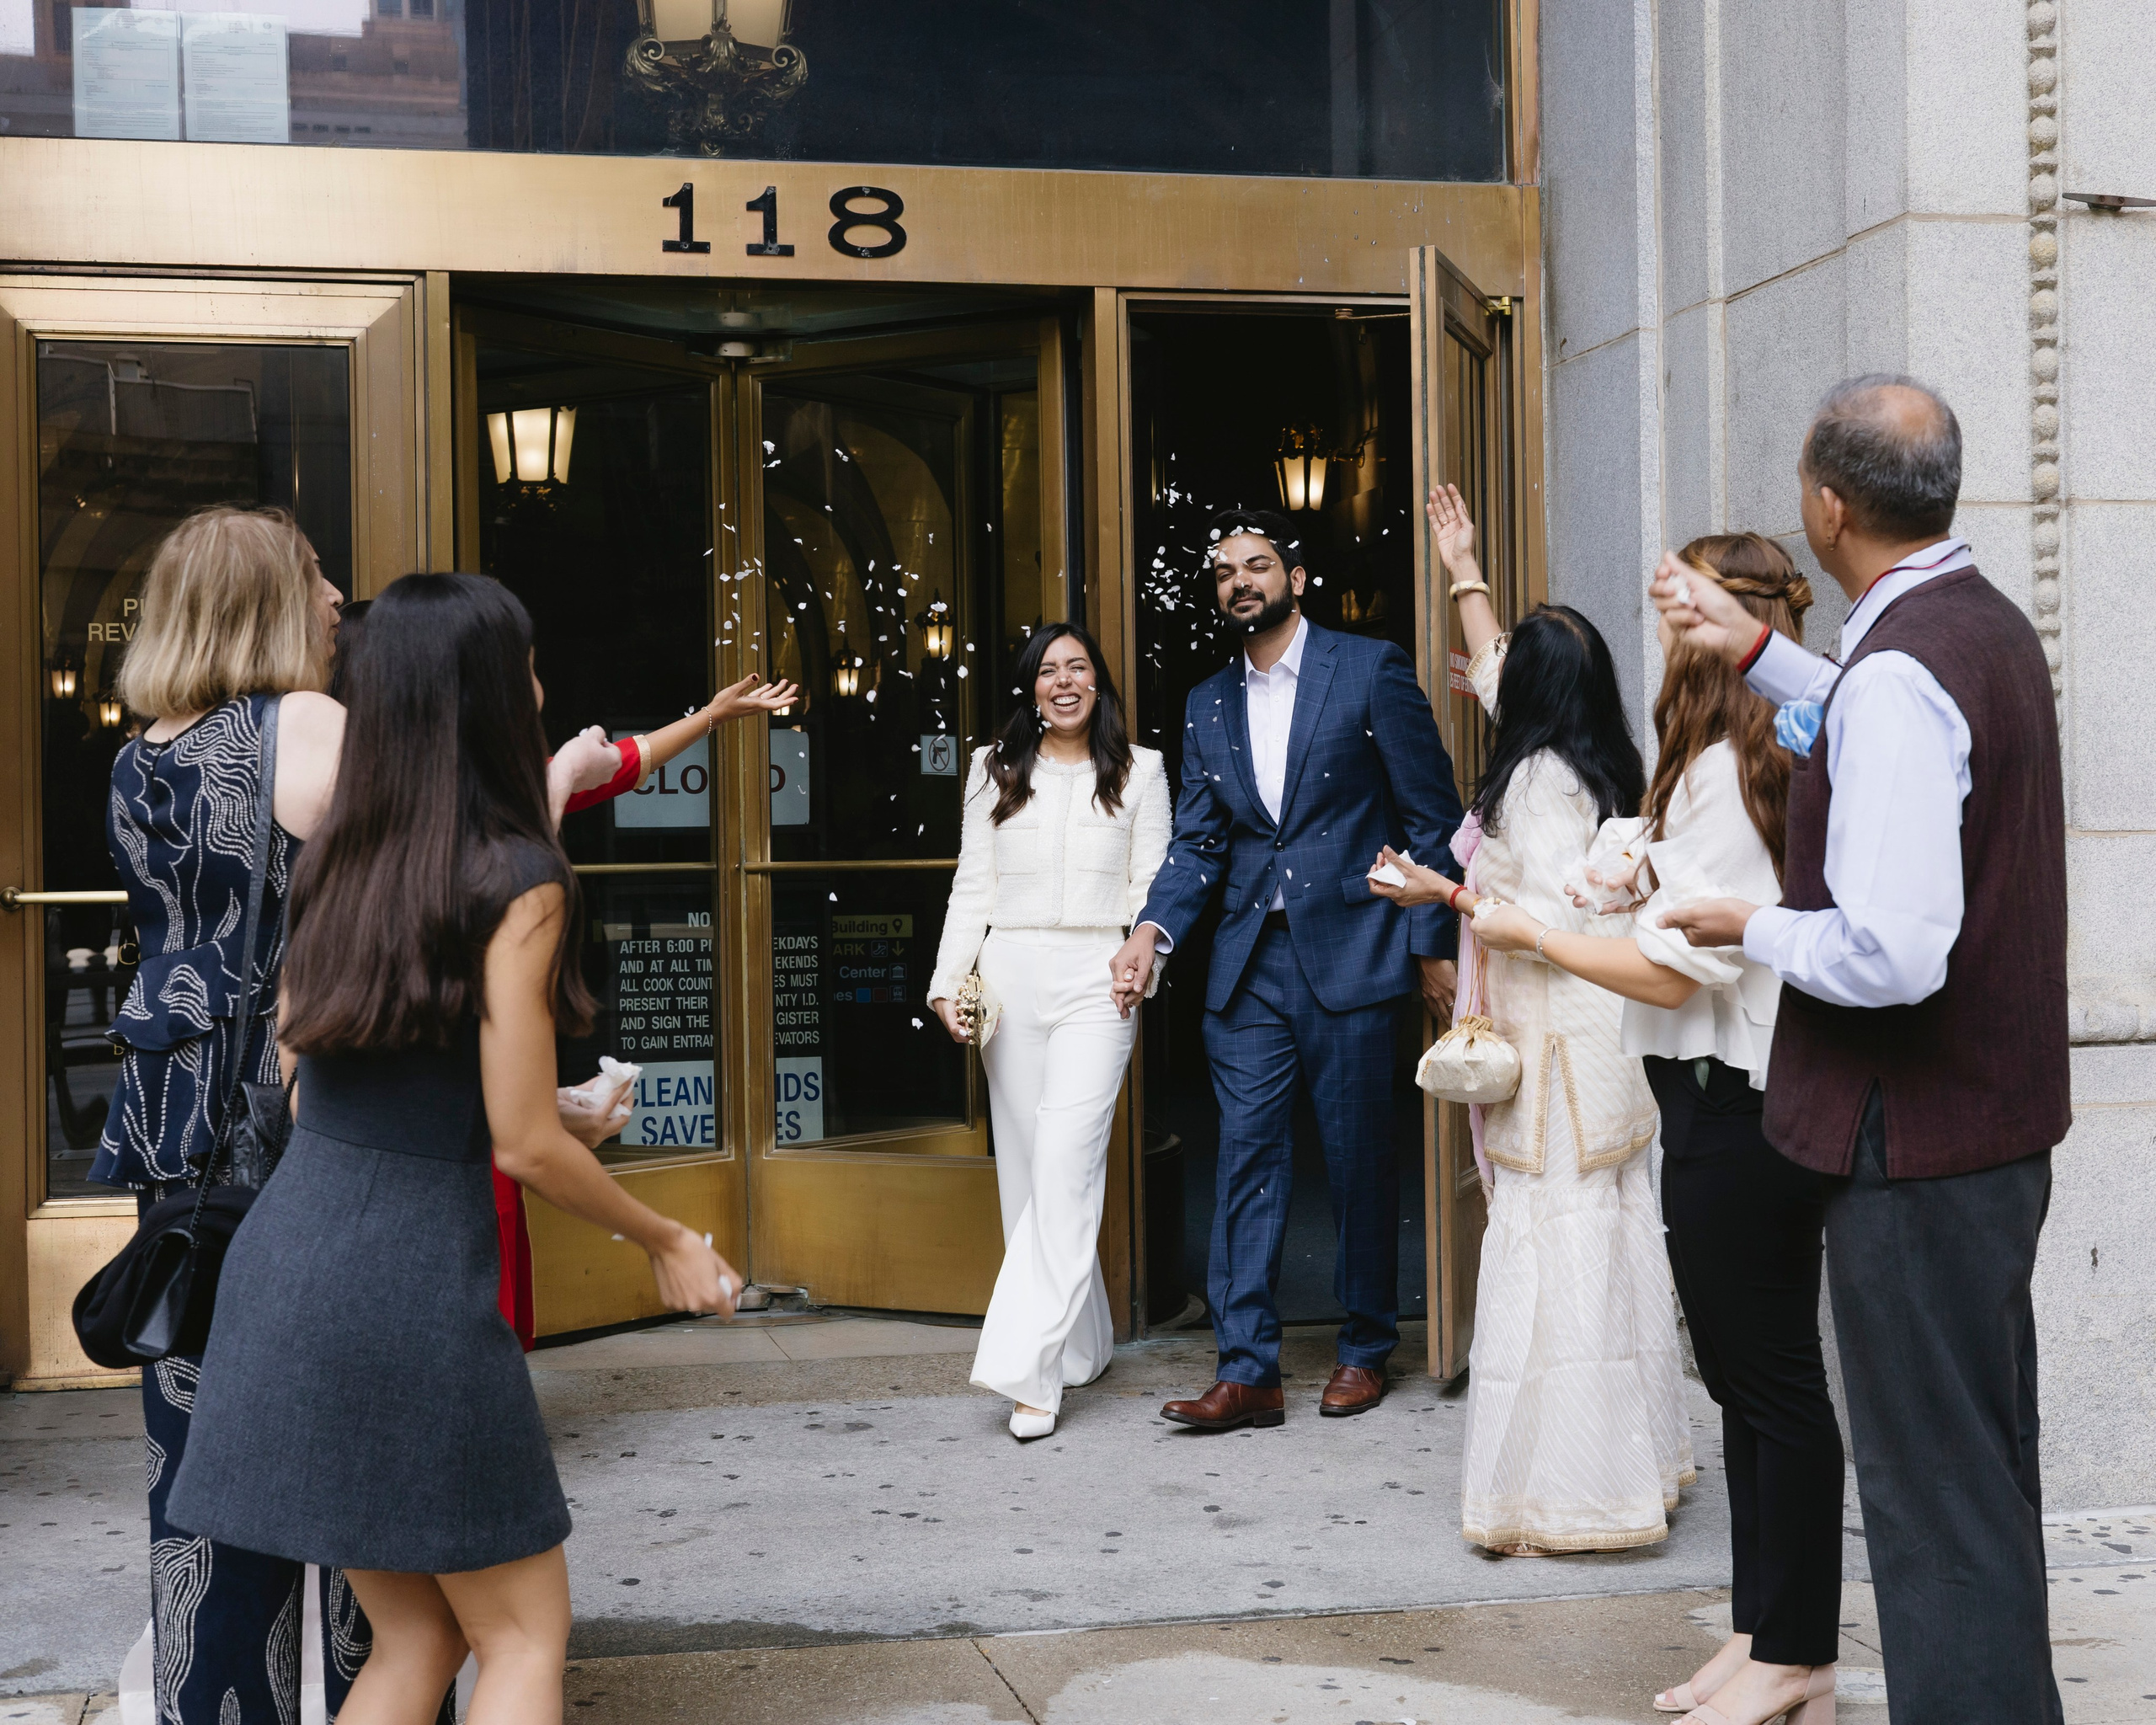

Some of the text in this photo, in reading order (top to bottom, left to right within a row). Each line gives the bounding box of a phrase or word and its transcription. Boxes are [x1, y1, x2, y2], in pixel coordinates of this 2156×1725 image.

[662, 182, 907, 259] 118
[88, 622, 136, 641] REV
[687, 911, 712, 927] NO
[620, 940, 660, 953] AFTER
[667, 939, 694, 953] 6:00
[620, 960, 644, 974] AND
[649, 959, 664, 973] AT
[670, 959, 690, 972] ALL
[839, 966, 887, 979] Center
[620, 979, 639, 992] ALL
[643, 978, 674, 991] COOK
[790, 974, 819, 987] MUST
[619, 997, 671, 1011] PRESENT
[675, 996, 708, 1010] THEIR
[802, 993, 819, 1006] I.D.
[621, 1017, 646, 1030] AND
[651, 1016, 680, 1029] SIGN
[686, 1015, 710, 1028] THE
[621, 1037, 636, 1050] TO
[641, 1036, 668, 1049] GAIN
